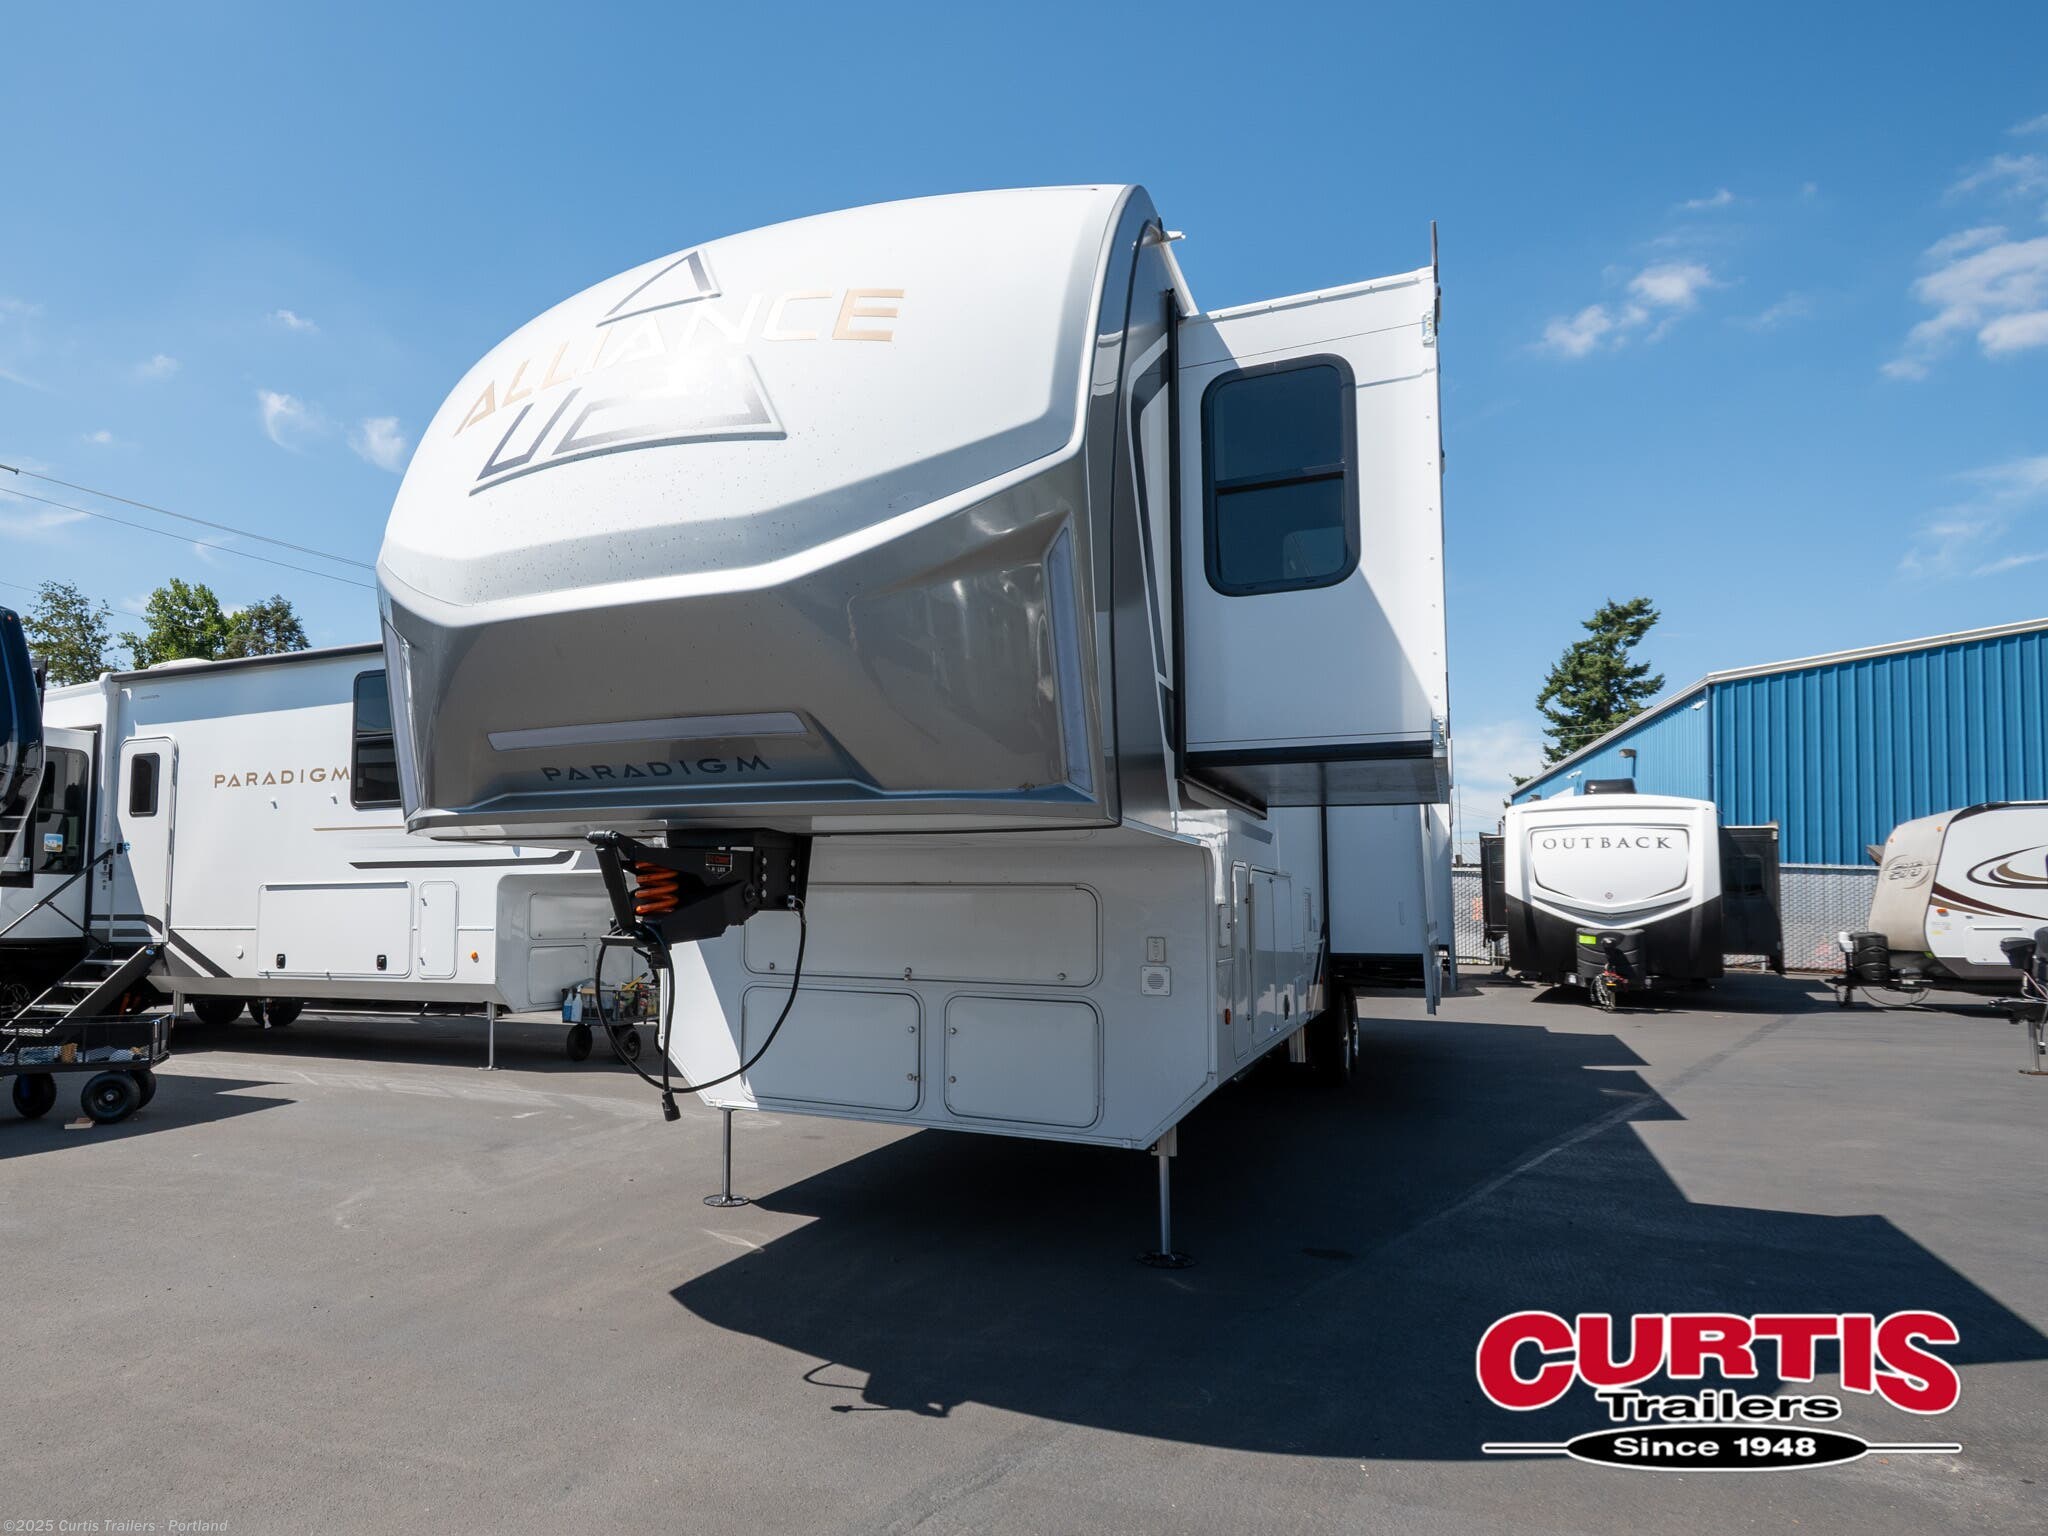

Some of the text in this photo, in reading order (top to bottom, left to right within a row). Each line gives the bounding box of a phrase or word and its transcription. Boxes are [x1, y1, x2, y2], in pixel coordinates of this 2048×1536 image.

[453, 287, 905, 438] ALLIANCE
[214, 766, 350, 788] PARADIGM
[540, 754, 771, 782] PARADIGM
[1542, 836, 1672, 849] OUTBACK
